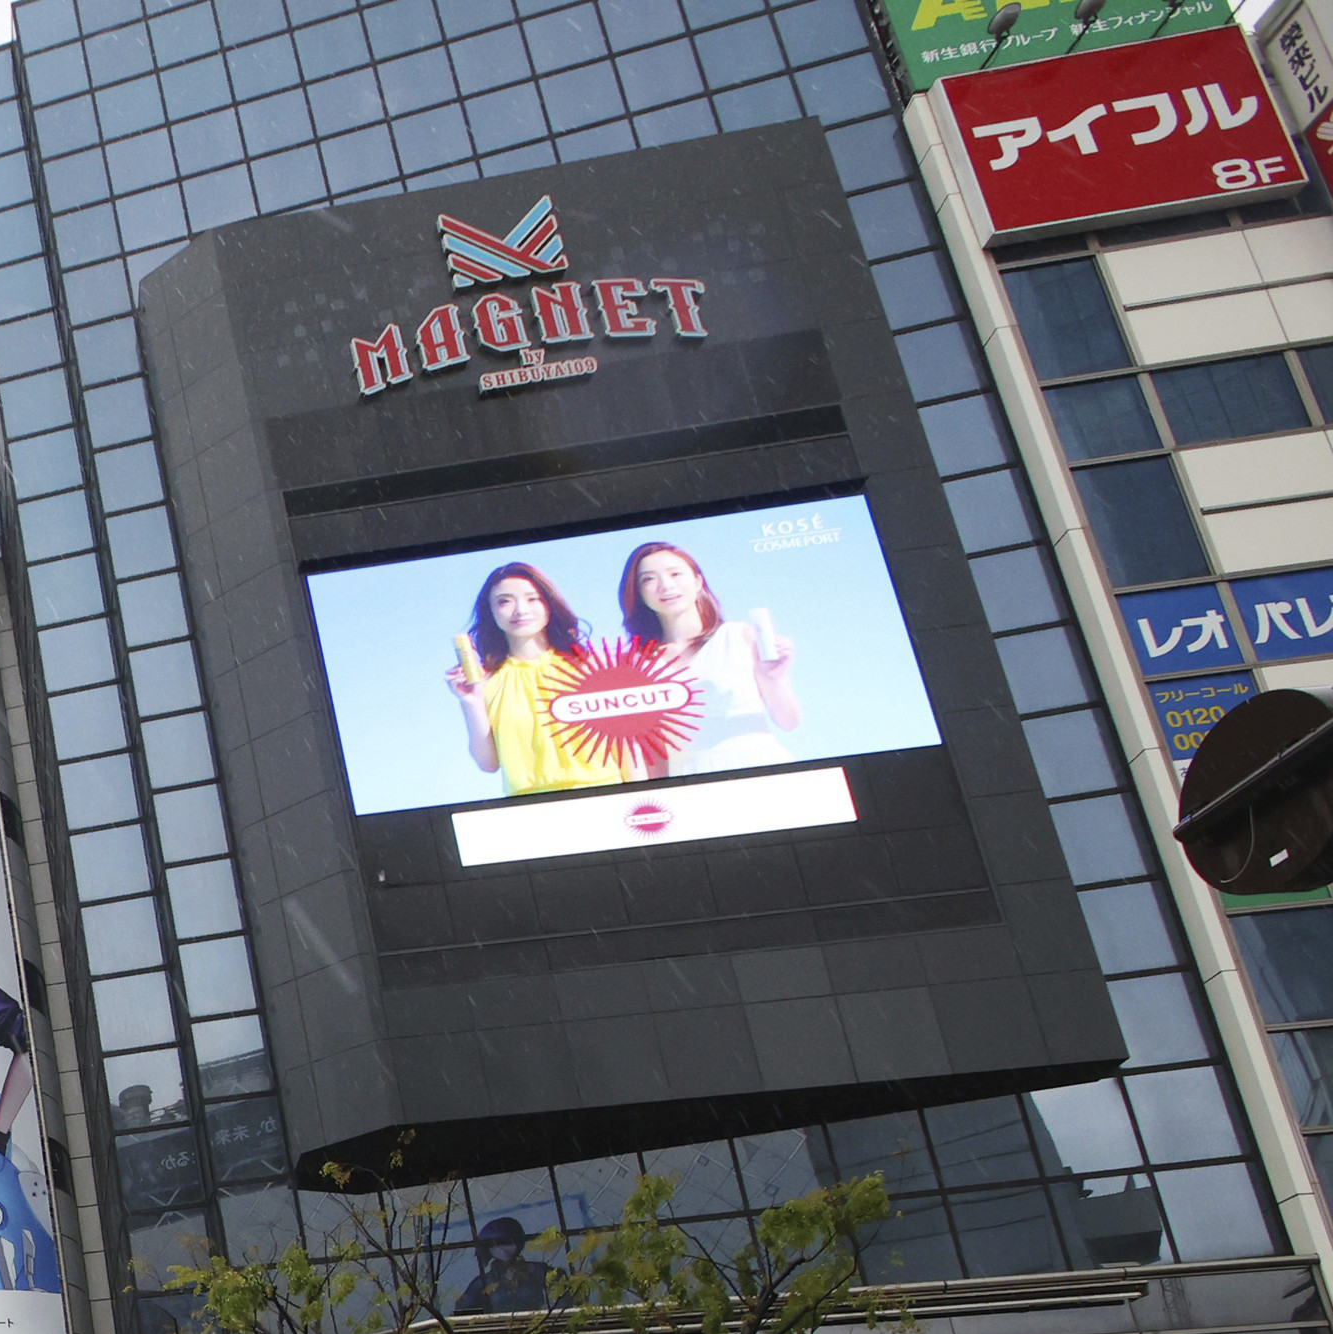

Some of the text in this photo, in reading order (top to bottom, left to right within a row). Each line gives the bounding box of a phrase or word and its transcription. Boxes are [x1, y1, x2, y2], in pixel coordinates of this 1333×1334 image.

[971, 83, 1259, 171] アイフル
[1211, 155, 1287, 190] 8F
[350, 278, 709, 396] MAGNET
[521, 349, 543, 366] by
[481, 358, 598, 391] SHIBUYA109
[761, 513, 825, 537] KOSÉ
[753, 532, 840, 553] COSMEPORT
[568, 689, 671, 714] SUNCUT
[1155, 683, 1249, 704] フリーコール
[1166, 705, 1225, 728] 0120
